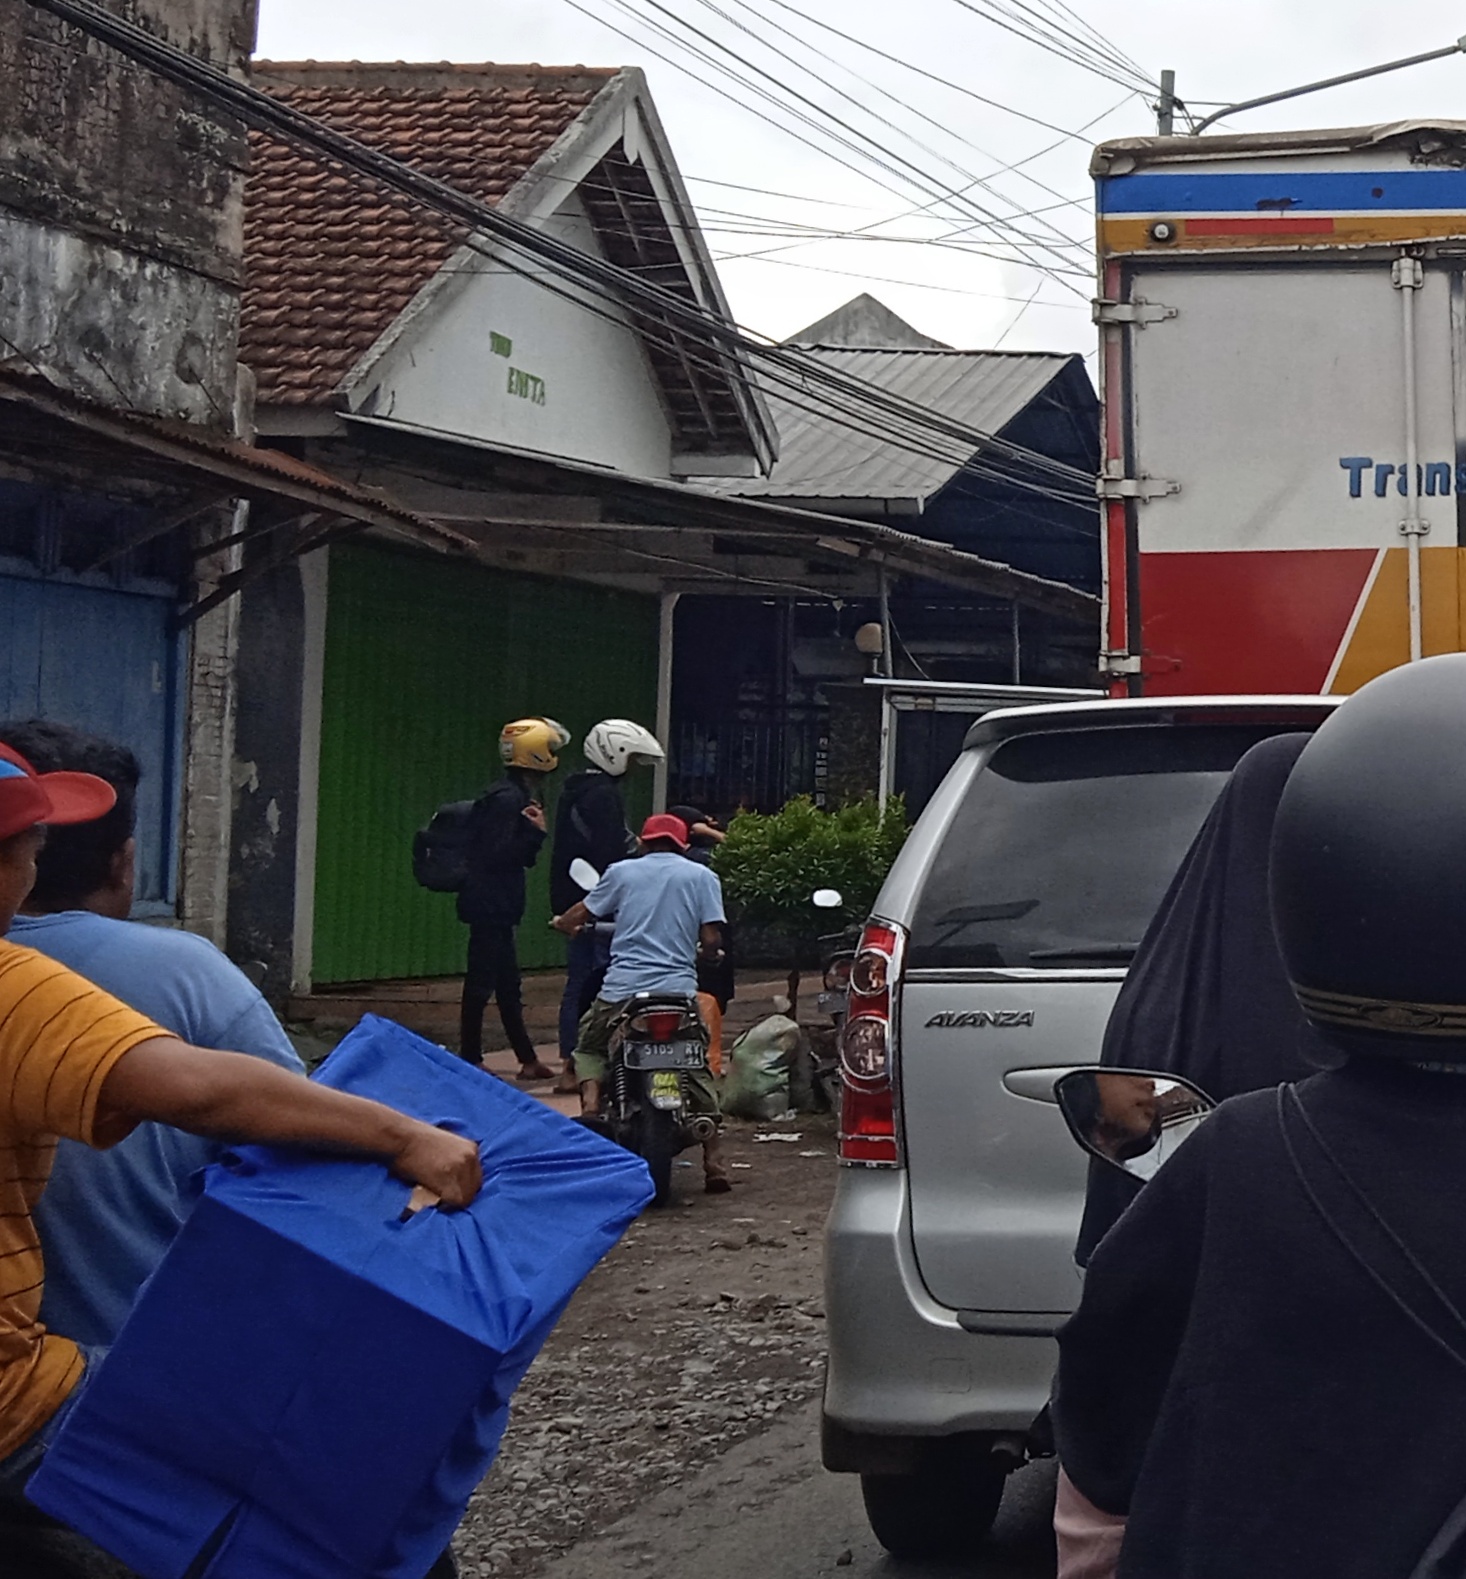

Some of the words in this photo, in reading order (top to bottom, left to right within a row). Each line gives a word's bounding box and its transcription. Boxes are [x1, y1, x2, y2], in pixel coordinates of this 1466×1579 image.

[924, 1009, 1035, 1029] AVANZA
[644, 1043, 674, 1056] 5105
[685, 1042, 700, 1055] RY
